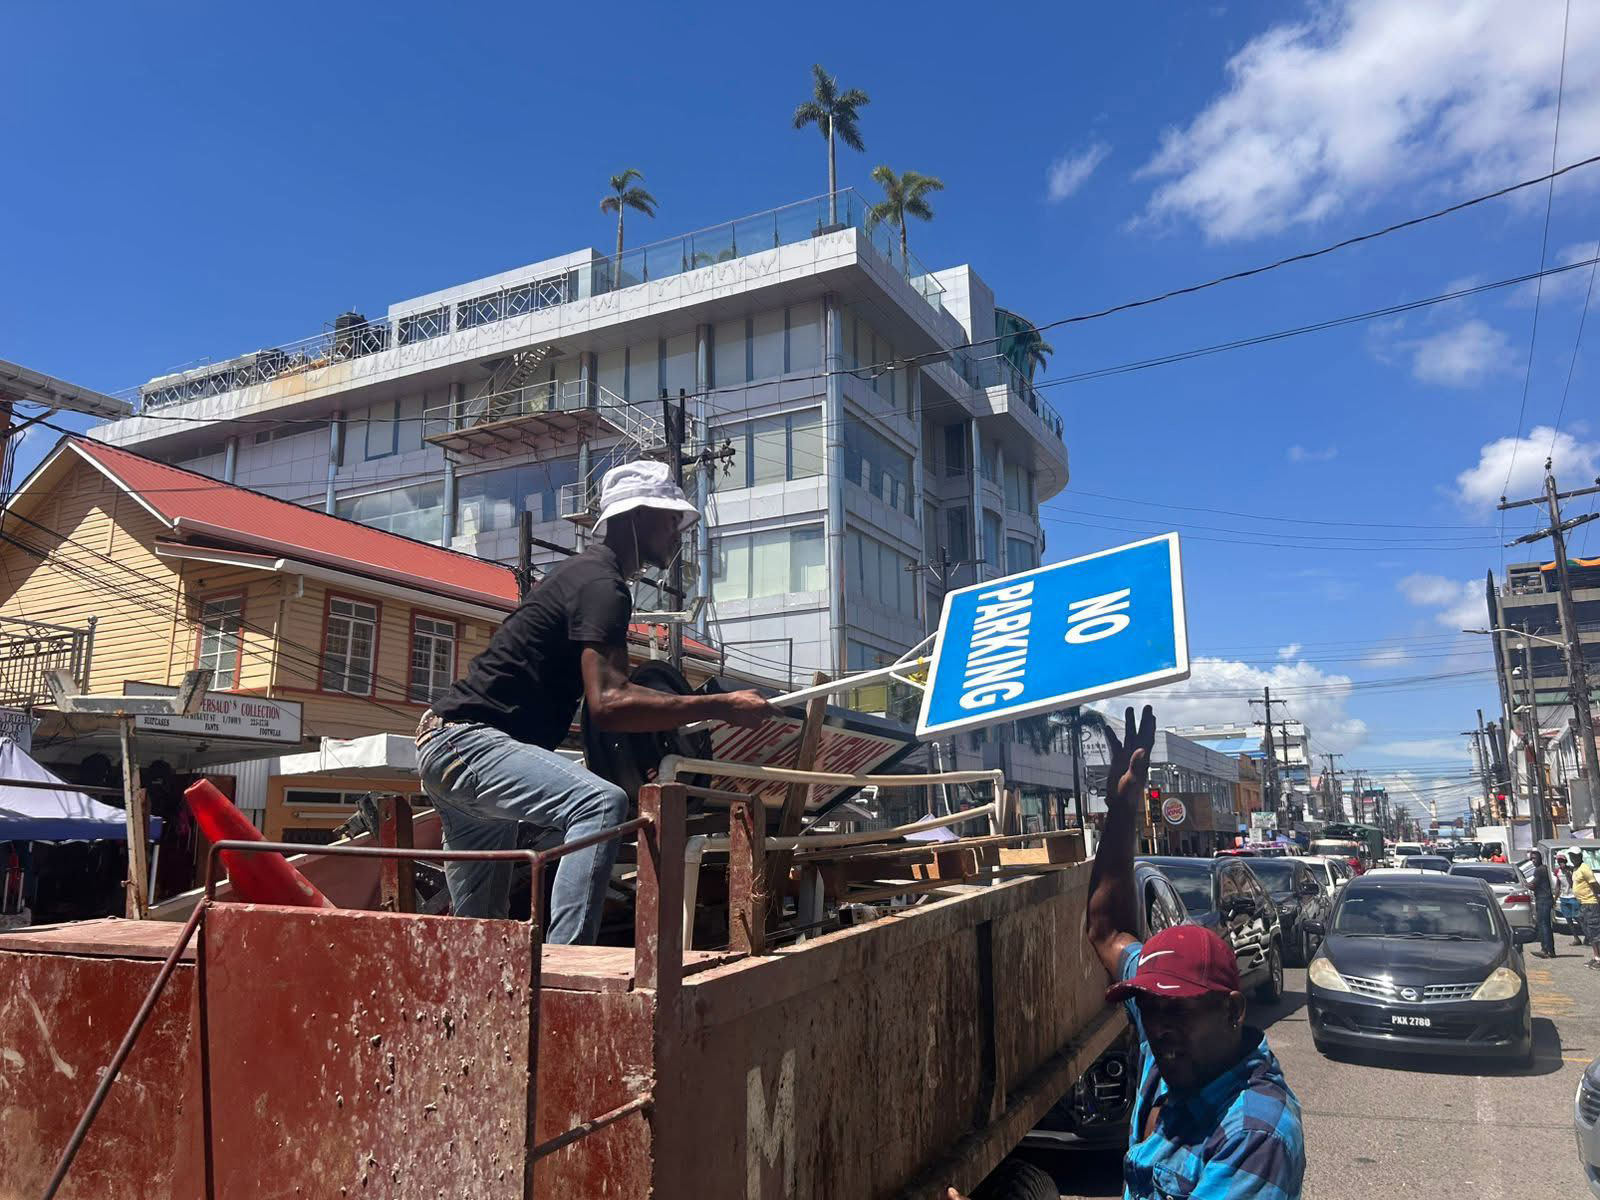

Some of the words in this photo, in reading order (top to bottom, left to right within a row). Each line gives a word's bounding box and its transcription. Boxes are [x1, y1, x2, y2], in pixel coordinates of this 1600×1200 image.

[1064, 588, 1131, 644] NO
[959, 580, 1035, 710] PARKING
[241, 703, 281, 720] COLLECTION
